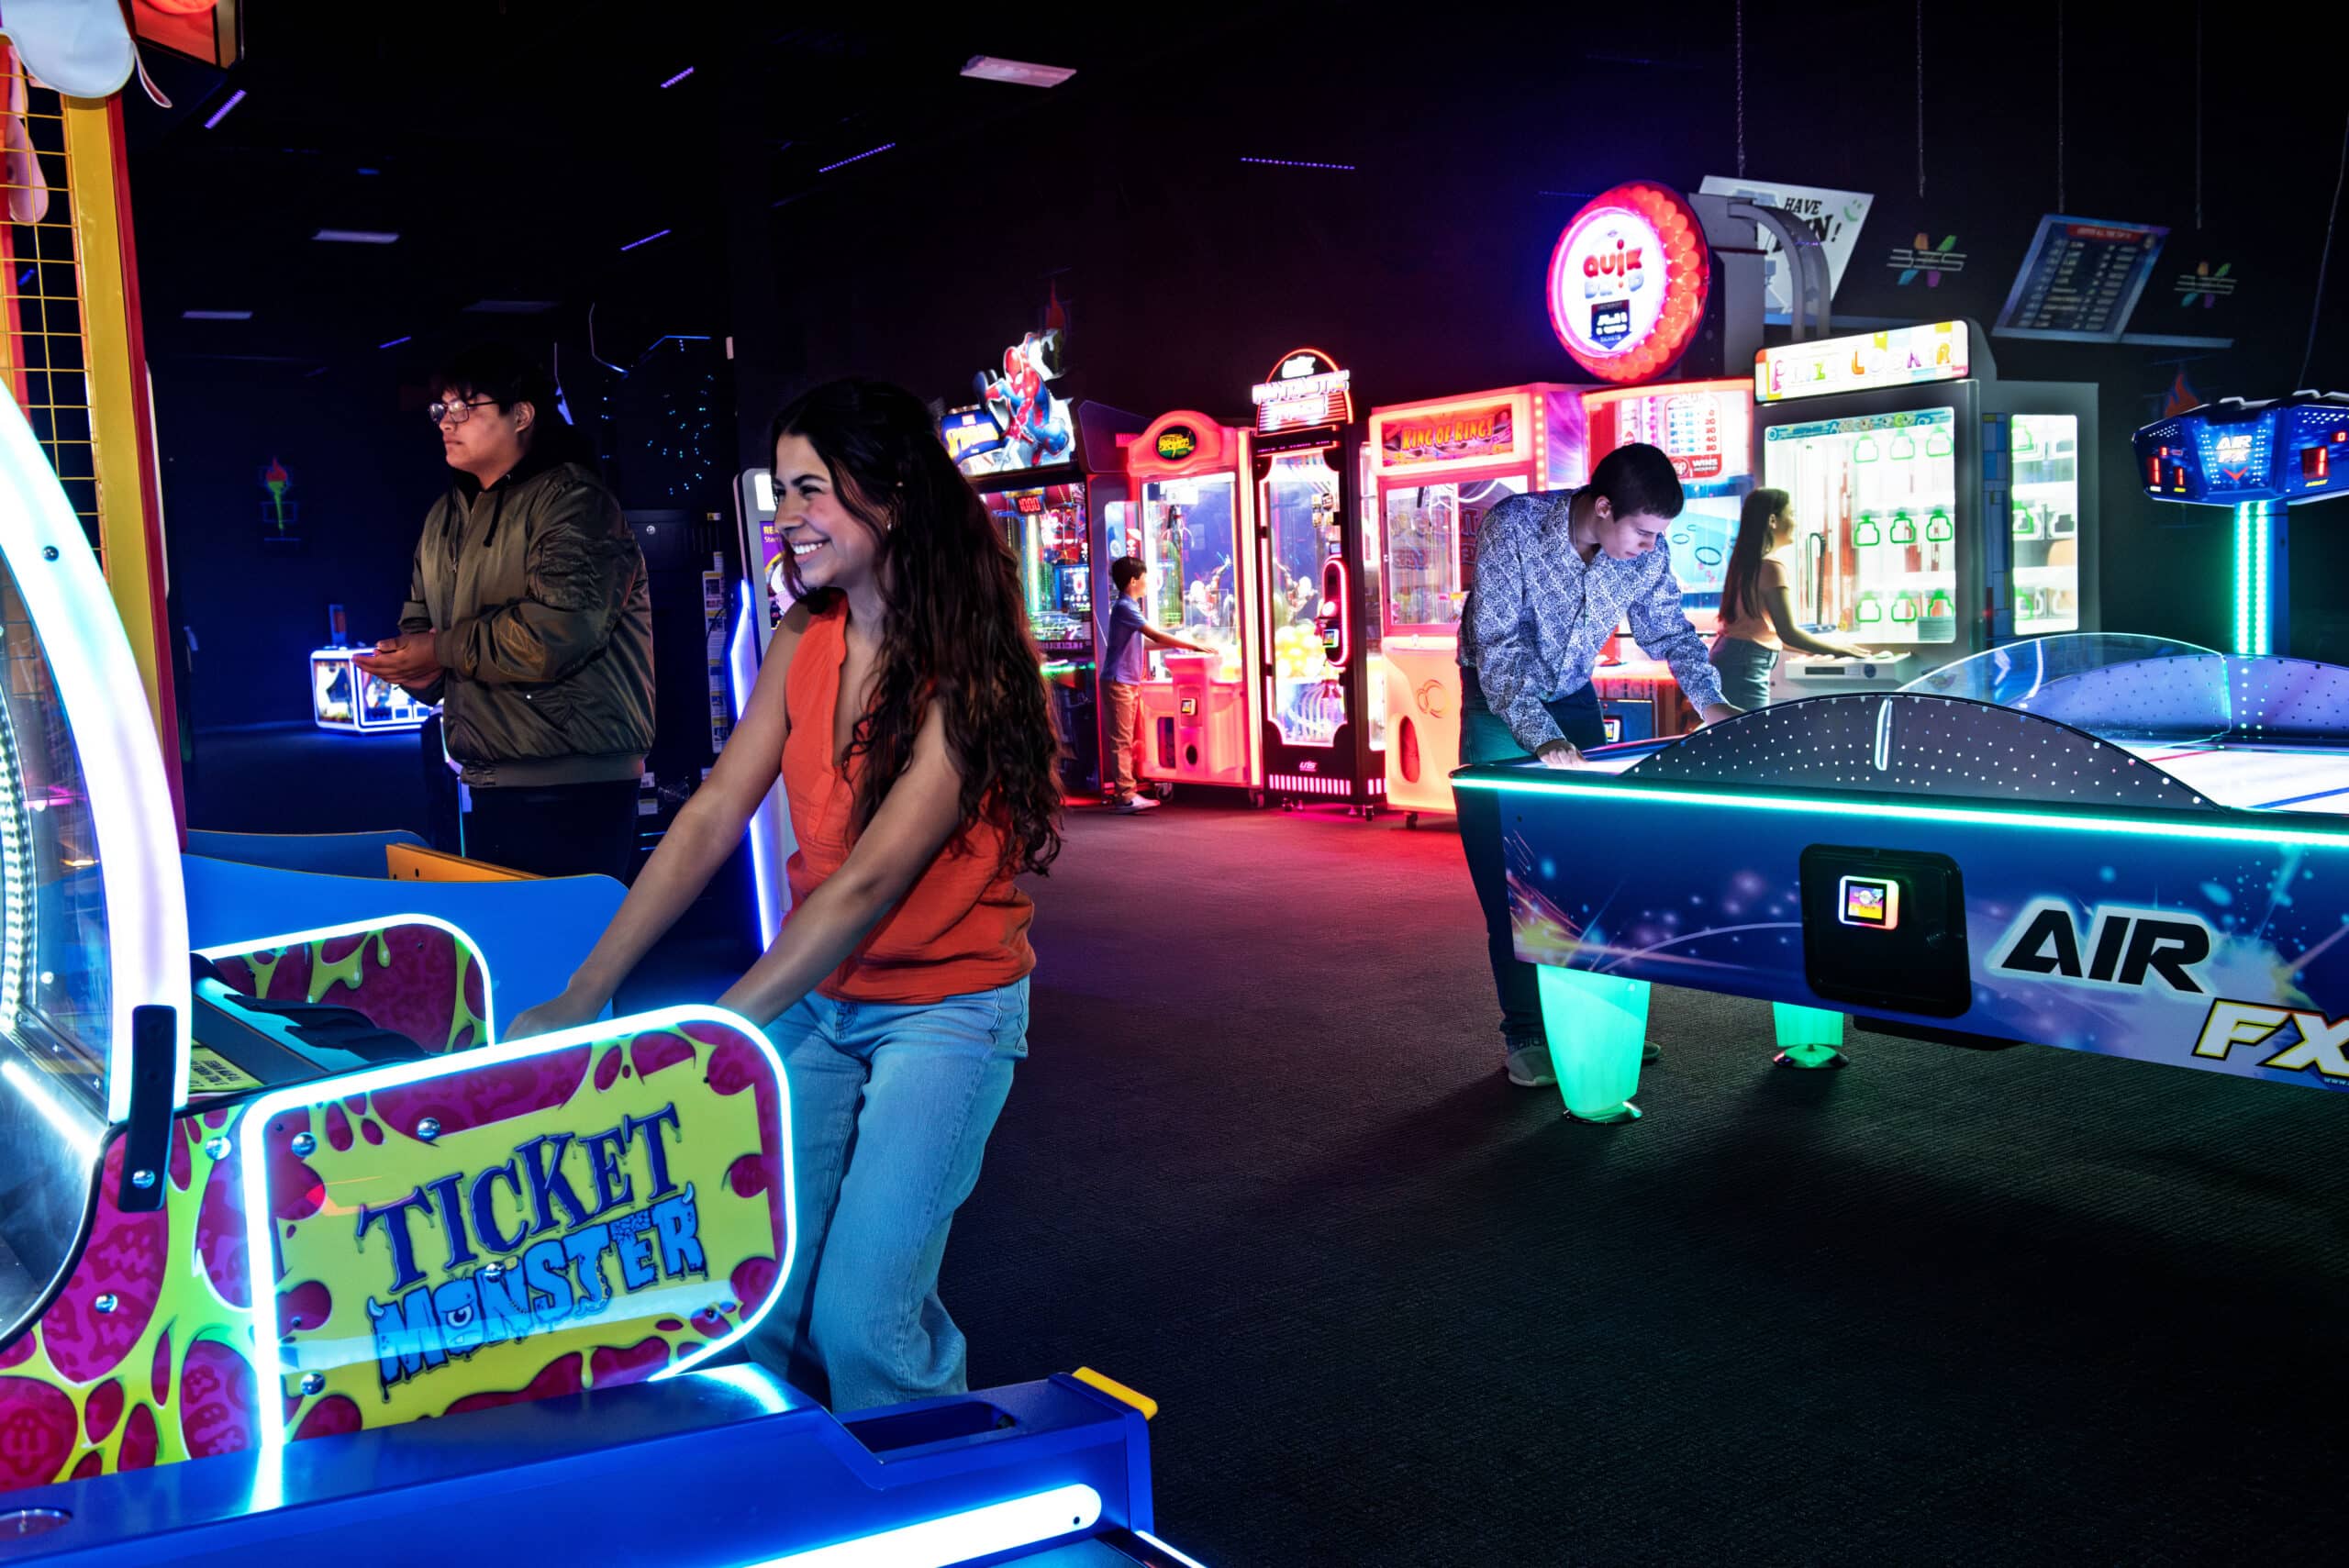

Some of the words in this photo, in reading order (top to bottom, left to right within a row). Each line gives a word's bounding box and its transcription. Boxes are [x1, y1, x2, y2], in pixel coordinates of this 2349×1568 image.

[1784, 197, 1822, 215] HAVE
[2215, 434, 2253, 450] AIR
[2000, 908, 2210, 995] AIR
[2191, 998, 2349, 1079] FX
[355, 1101, 683, 1294] TICKET
[365, 1182, 708, 1400] MONSTER
